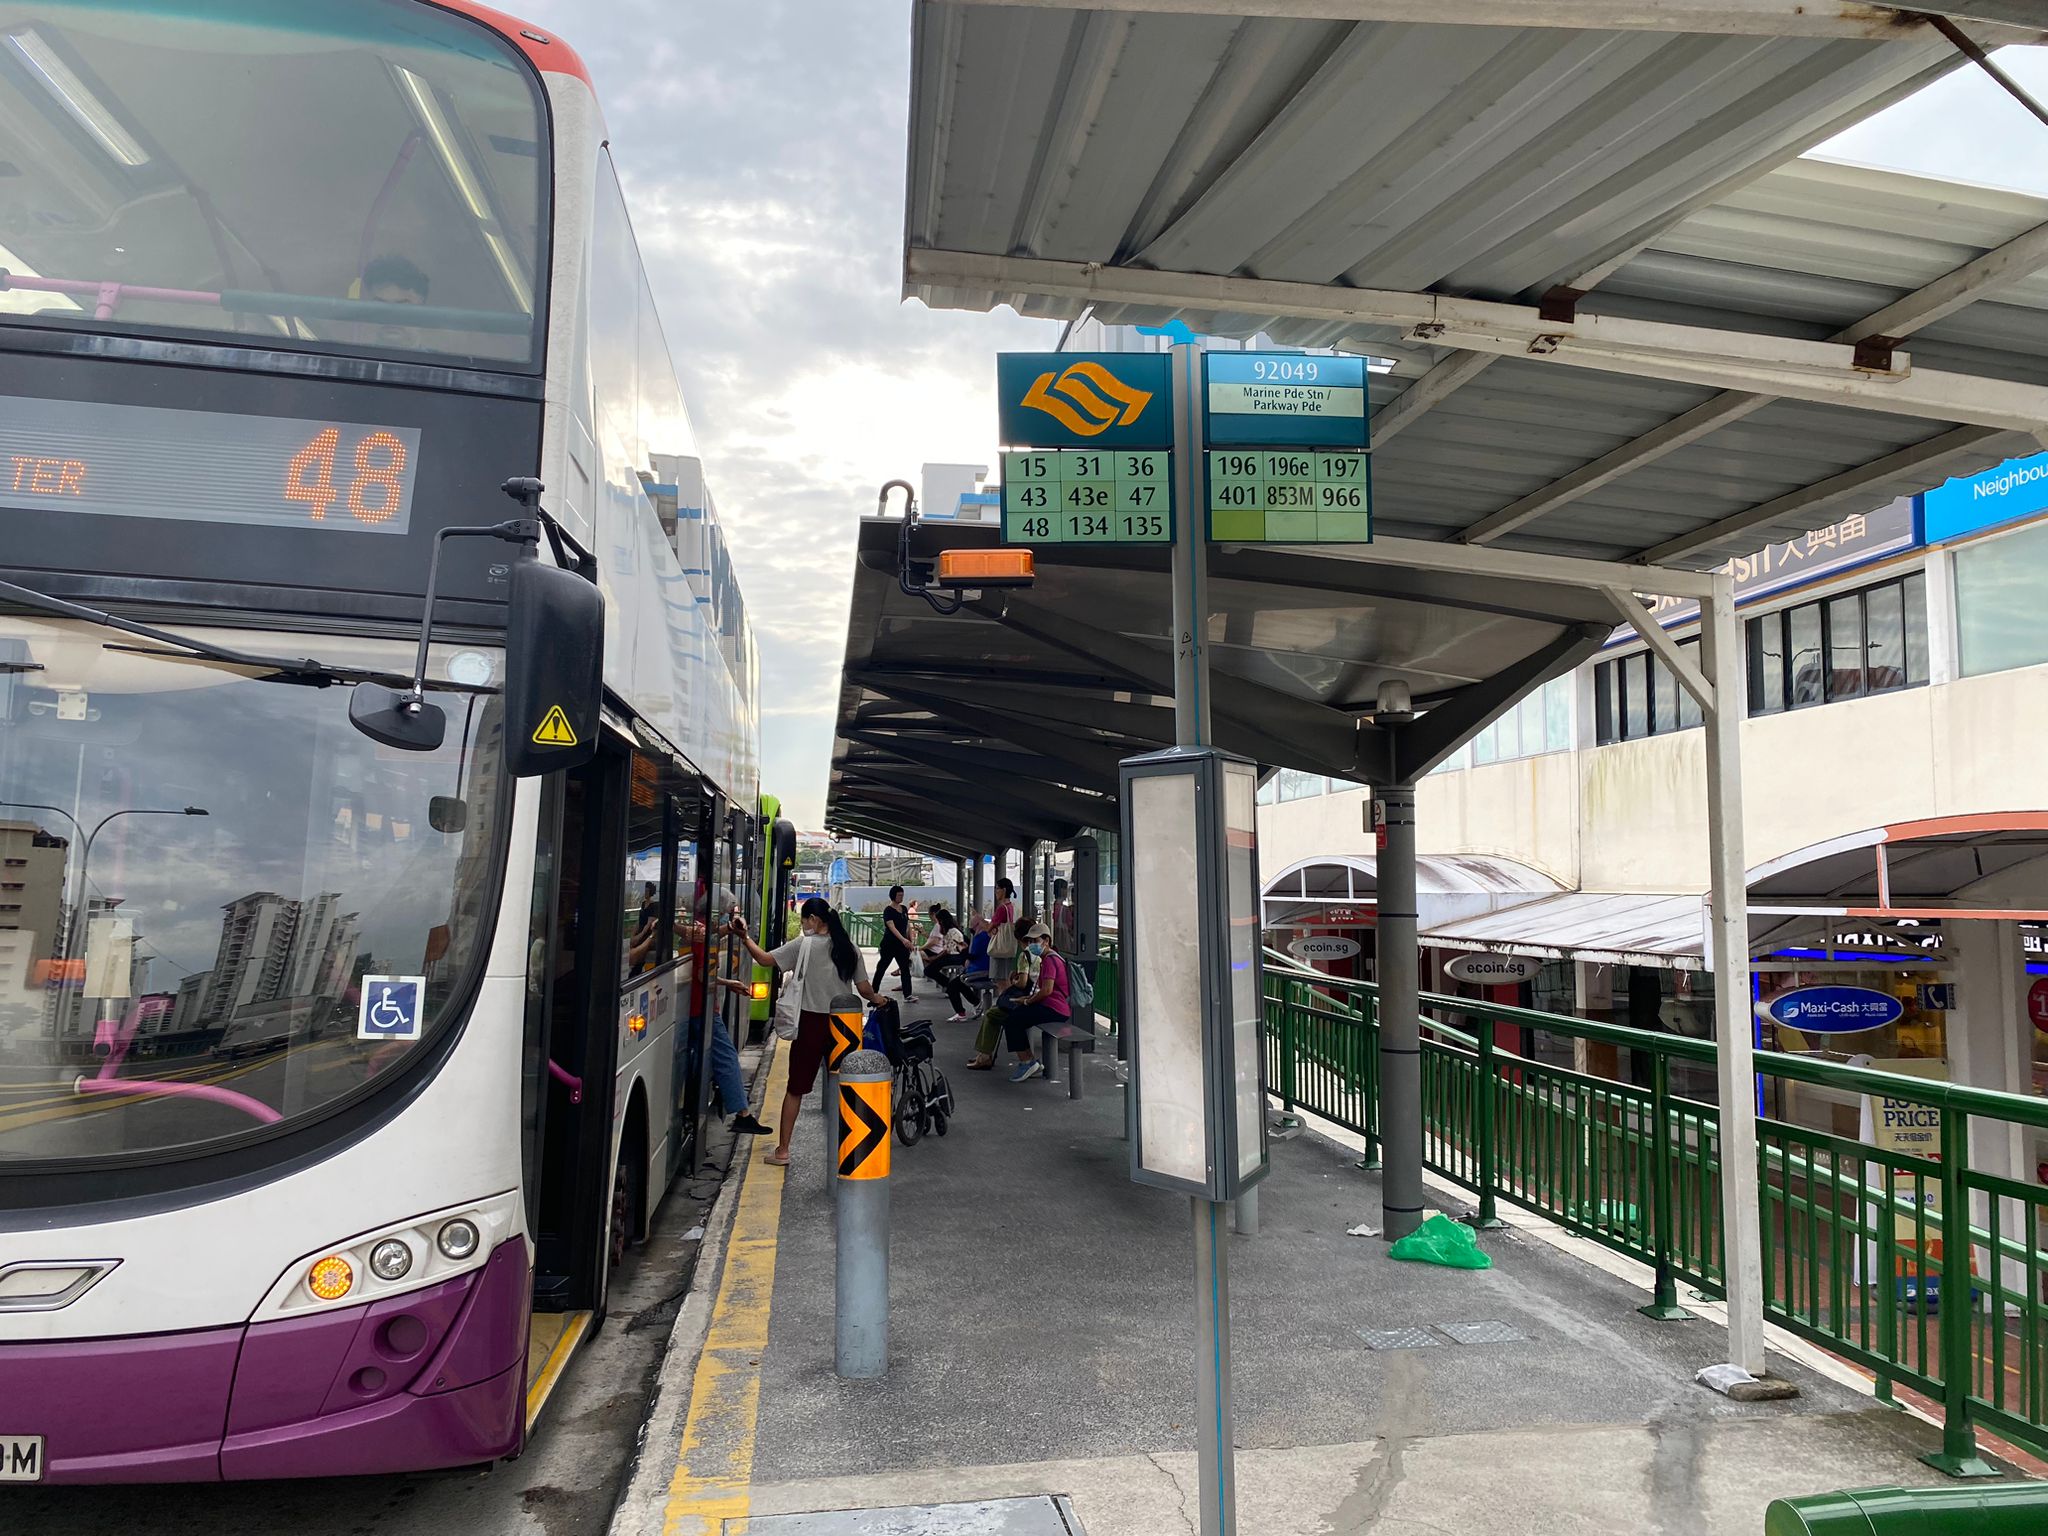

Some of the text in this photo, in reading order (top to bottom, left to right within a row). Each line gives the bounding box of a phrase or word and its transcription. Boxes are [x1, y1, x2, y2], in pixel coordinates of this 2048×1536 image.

[1254, 361, 1318, 381] 92049
[1243, 387, 1332, 400] Marine Pde Stn /
[1253, 399, 1322, 413] Parkway Pde
[10, 427, 407, 523] TER 48
[1020, 456, 1154, 477] 15 31 36
[1217, 456, 1360, 478] 196 196e 197
[1020, 486, 1156, 507] 43 43e 47
[1218, 485, 1361, 507] 401 853M 966
[1022, 515, 1163, 537] 48 134 135
[1303, 943, 1349, 954] ecoin.sg
[1467, 962, 1525, 976] ecoin.sg
[1800, 1002, 1859, 1013] Maxi-Cash
[1883, 1110, 1940, 1127] PRICE
